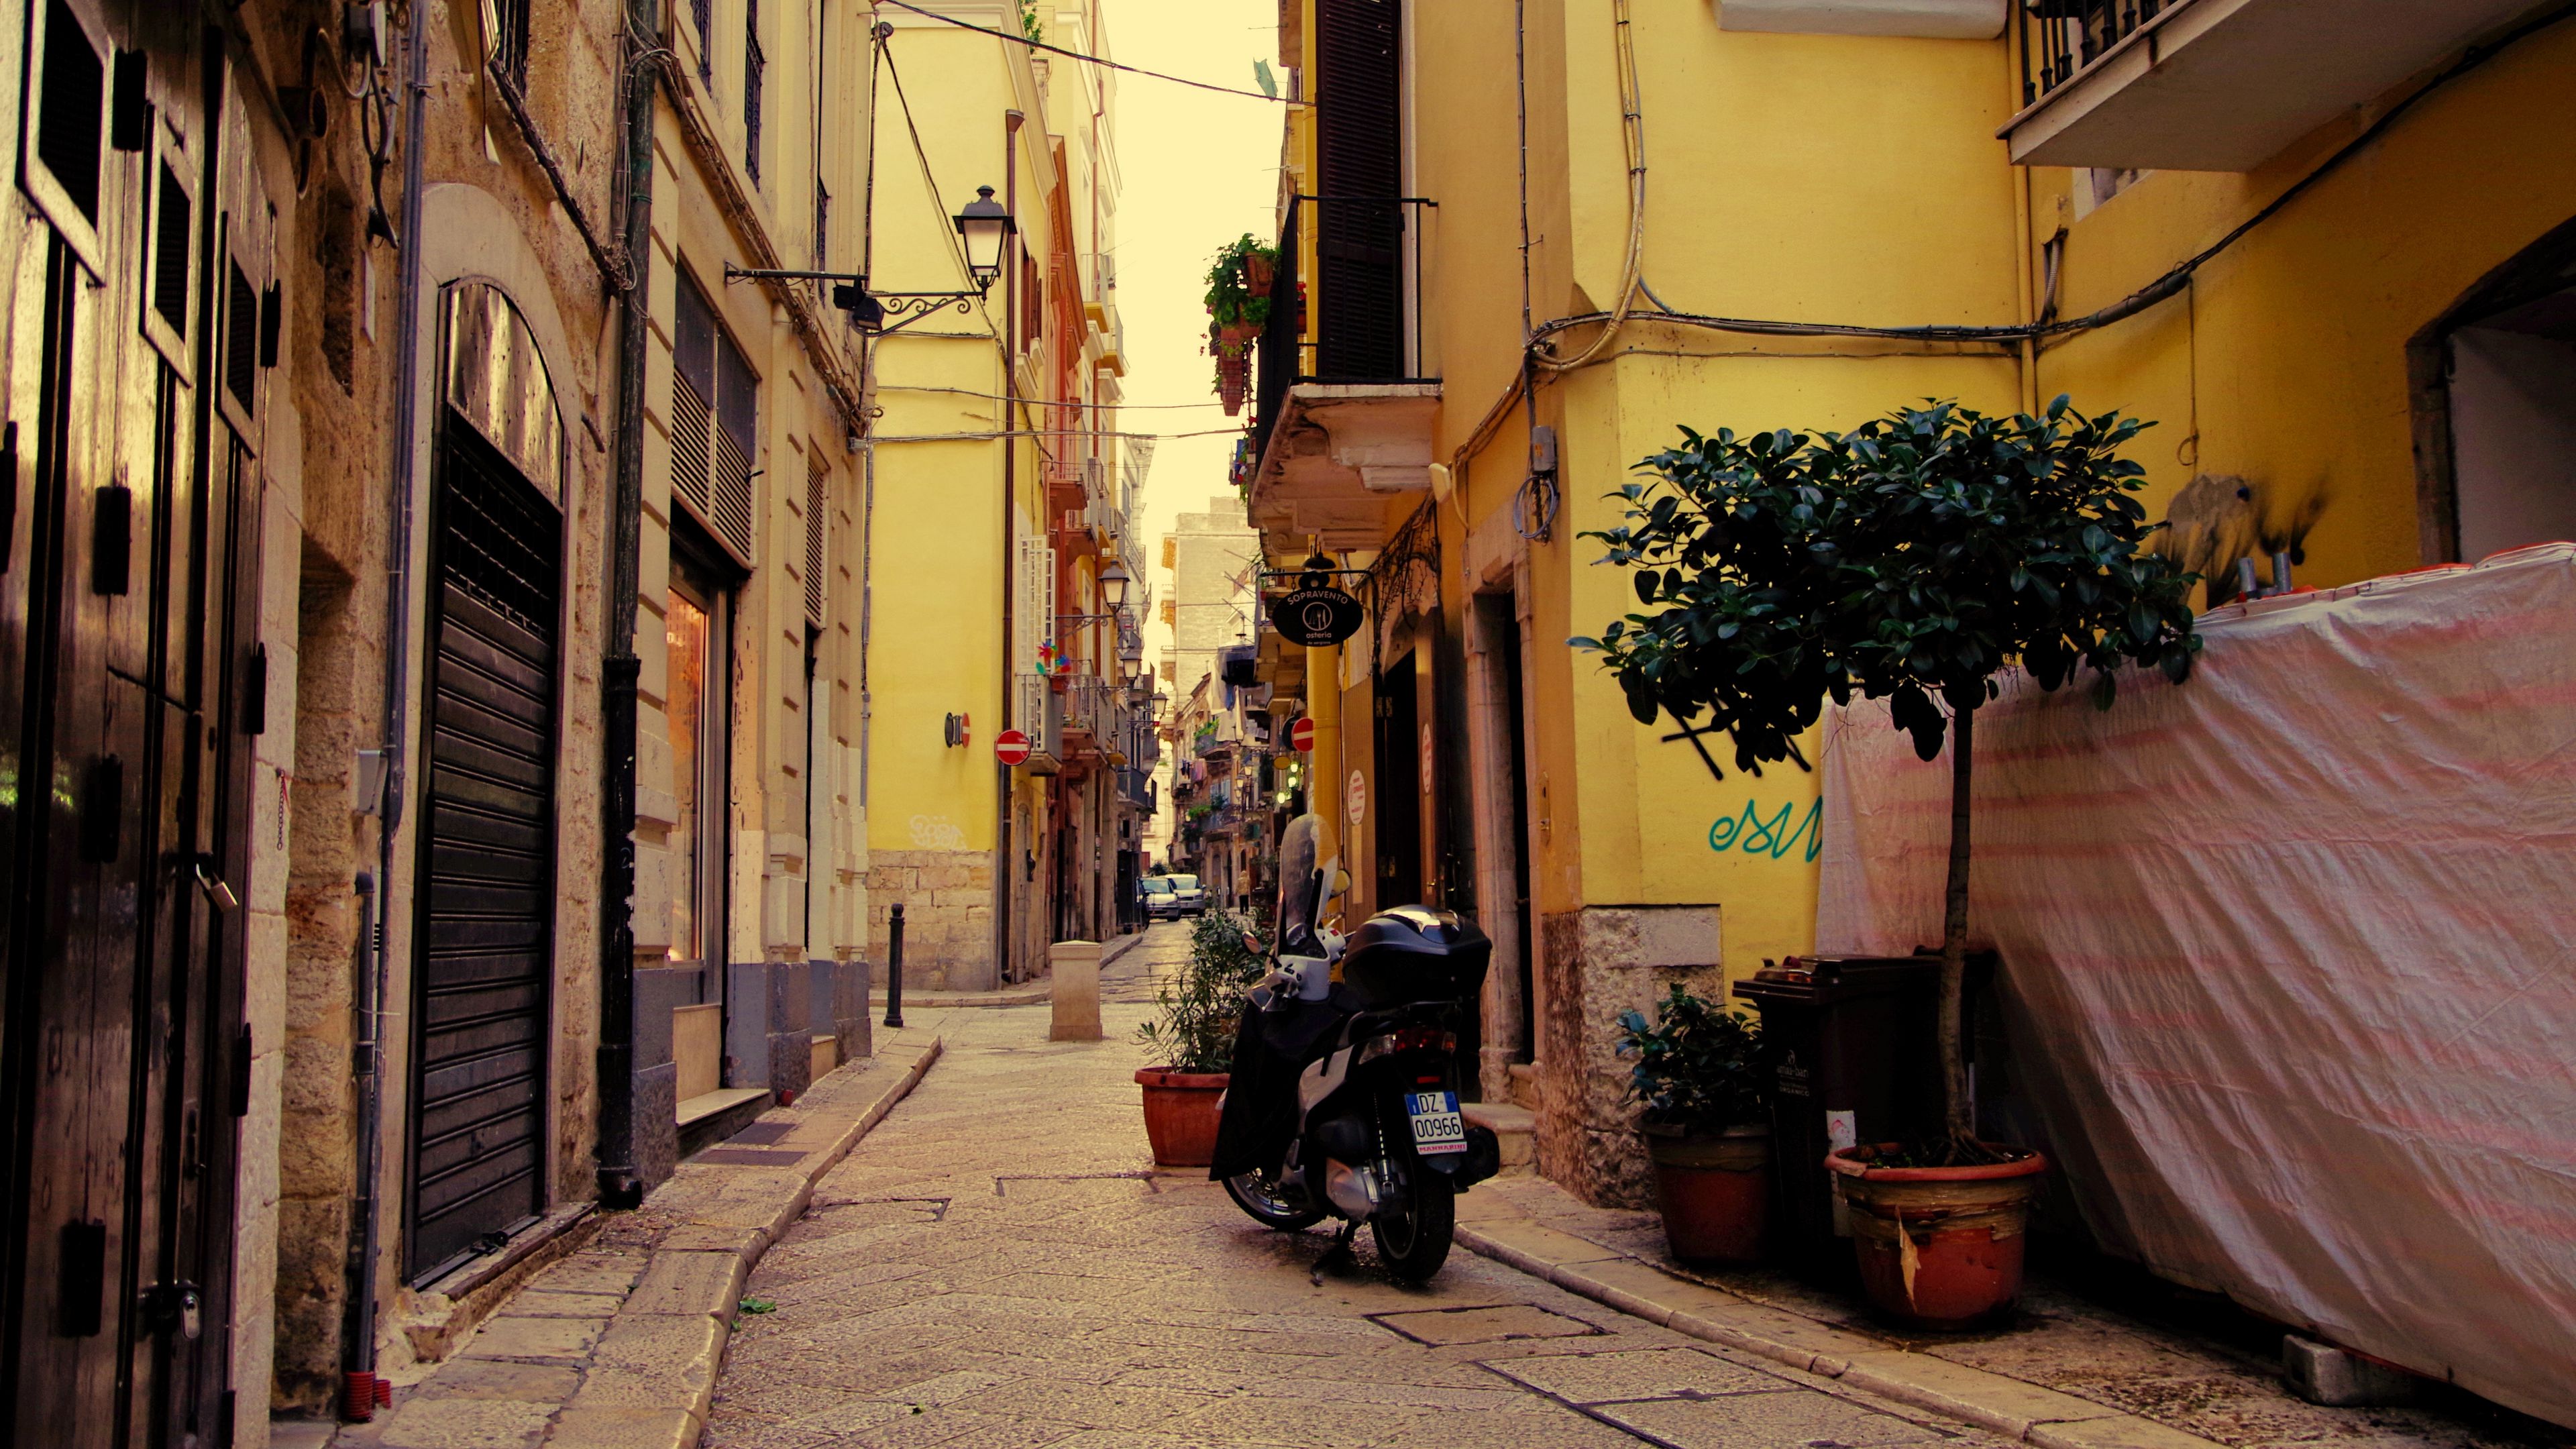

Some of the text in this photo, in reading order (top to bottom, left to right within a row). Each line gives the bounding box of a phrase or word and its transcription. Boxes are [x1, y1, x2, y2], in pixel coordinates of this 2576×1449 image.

[1287, 590, 1348, 604] SOPRAVENTO
[1419, 1094, 1439, 1113] DZ
[1415, 1117, 1460, 1138] 00966
